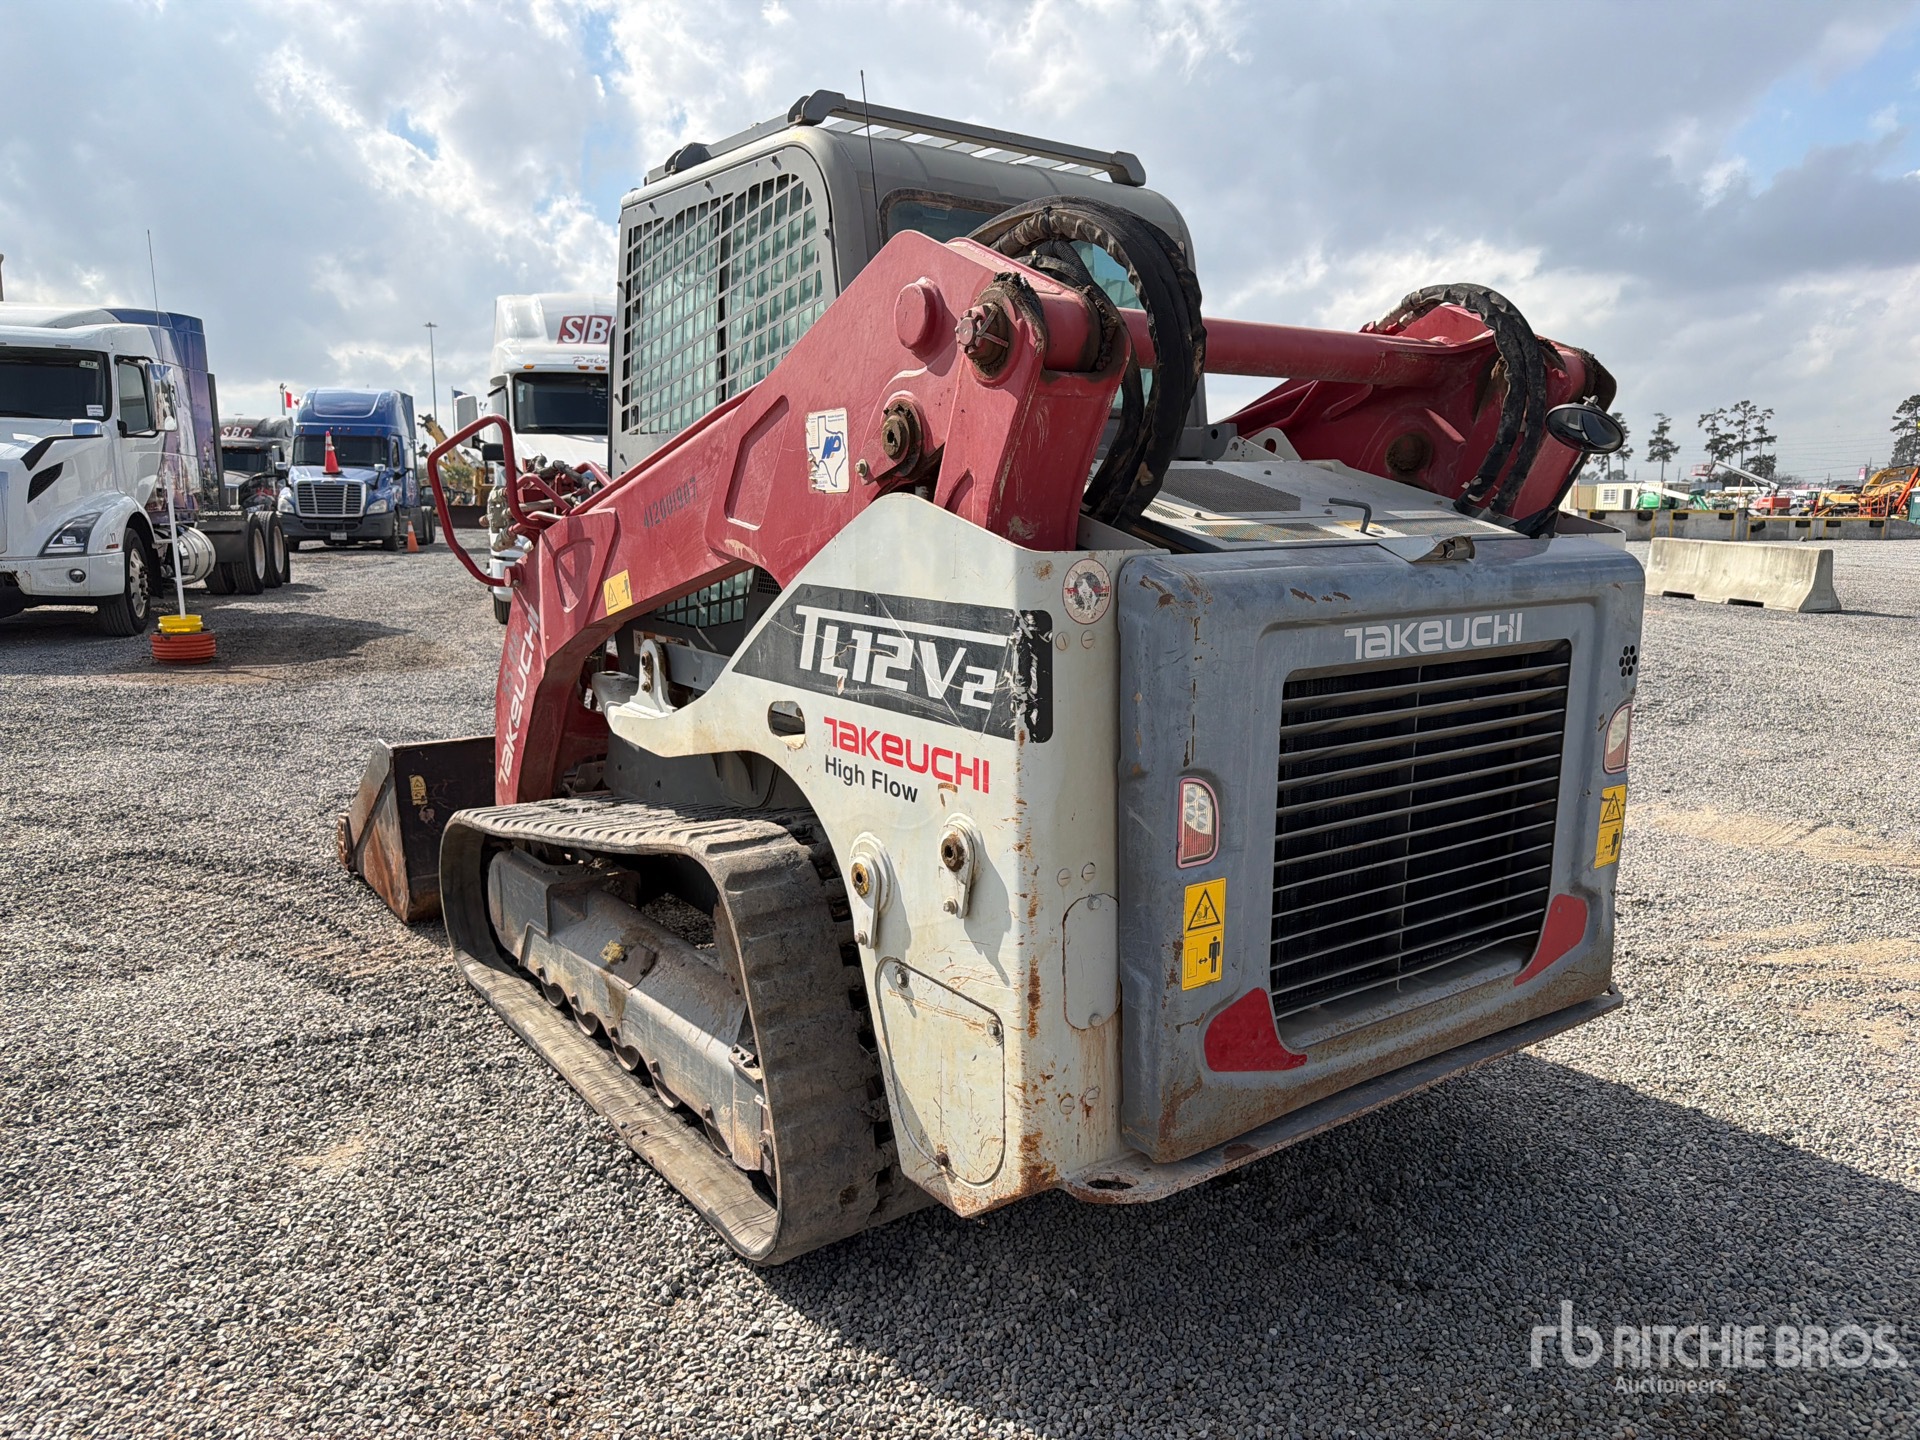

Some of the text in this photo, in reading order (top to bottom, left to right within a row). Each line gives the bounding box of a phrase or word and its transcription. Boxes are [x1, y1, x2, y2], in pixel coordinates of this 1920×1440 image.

[561, 316, 609, 344] SB
[221, 426, 252, 438] SBC
[795, 604, 1009, 711] TL12V2
[1344, 612, 1523, 661] TAKEUCHI
[498, 602, 540, 786] TAKEUCHI
[824, 716, 990, 794] TAKEUCHI
[825, 754, 919, 803] High Flow
